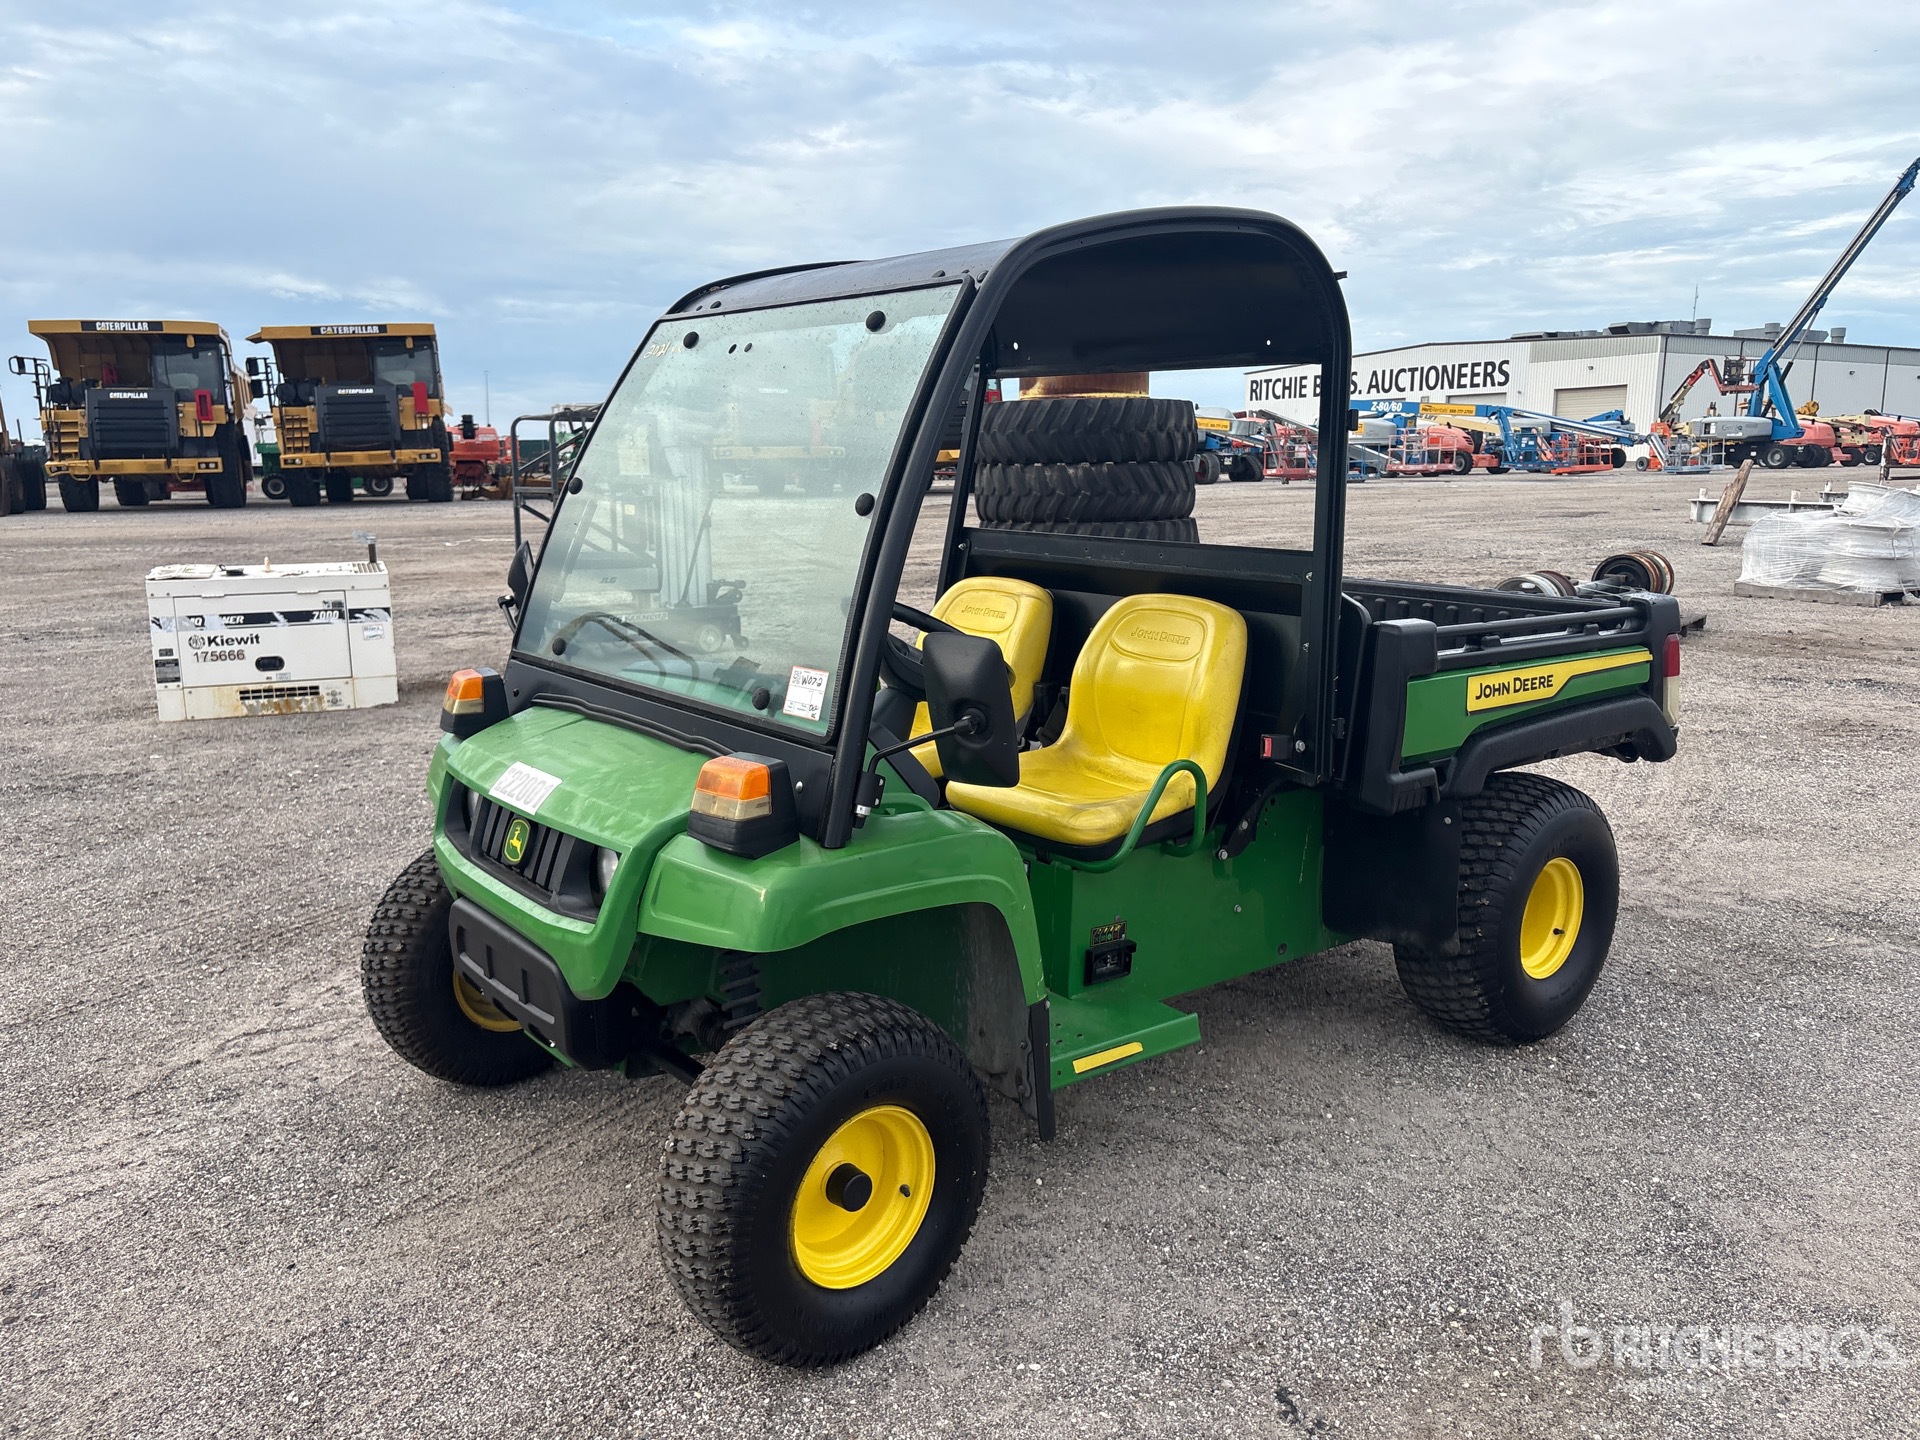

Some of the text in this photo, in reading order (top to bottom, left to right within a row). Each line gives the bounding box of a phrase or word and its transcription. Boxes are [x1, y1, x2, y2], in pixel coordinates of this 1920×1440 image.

[96, 321, 149, 331] CATERPILLAR
[320, 325, 380, 334] CATERPILLAR
[1249, 360, 1510, 401] RITCHIE BS. AUCTIONEERS
[1370, 401, 1402, 412] Z-80/60
[961, 605, 1007, 619] JOHN DEERE
[207, 634, 260, 647] Kiewit
[1131, 627, 1191, 645] JOHN DEERE
[193, 649, 245, 663] 175666
[1475, 674, 1554, 700] JOHN DEERE
